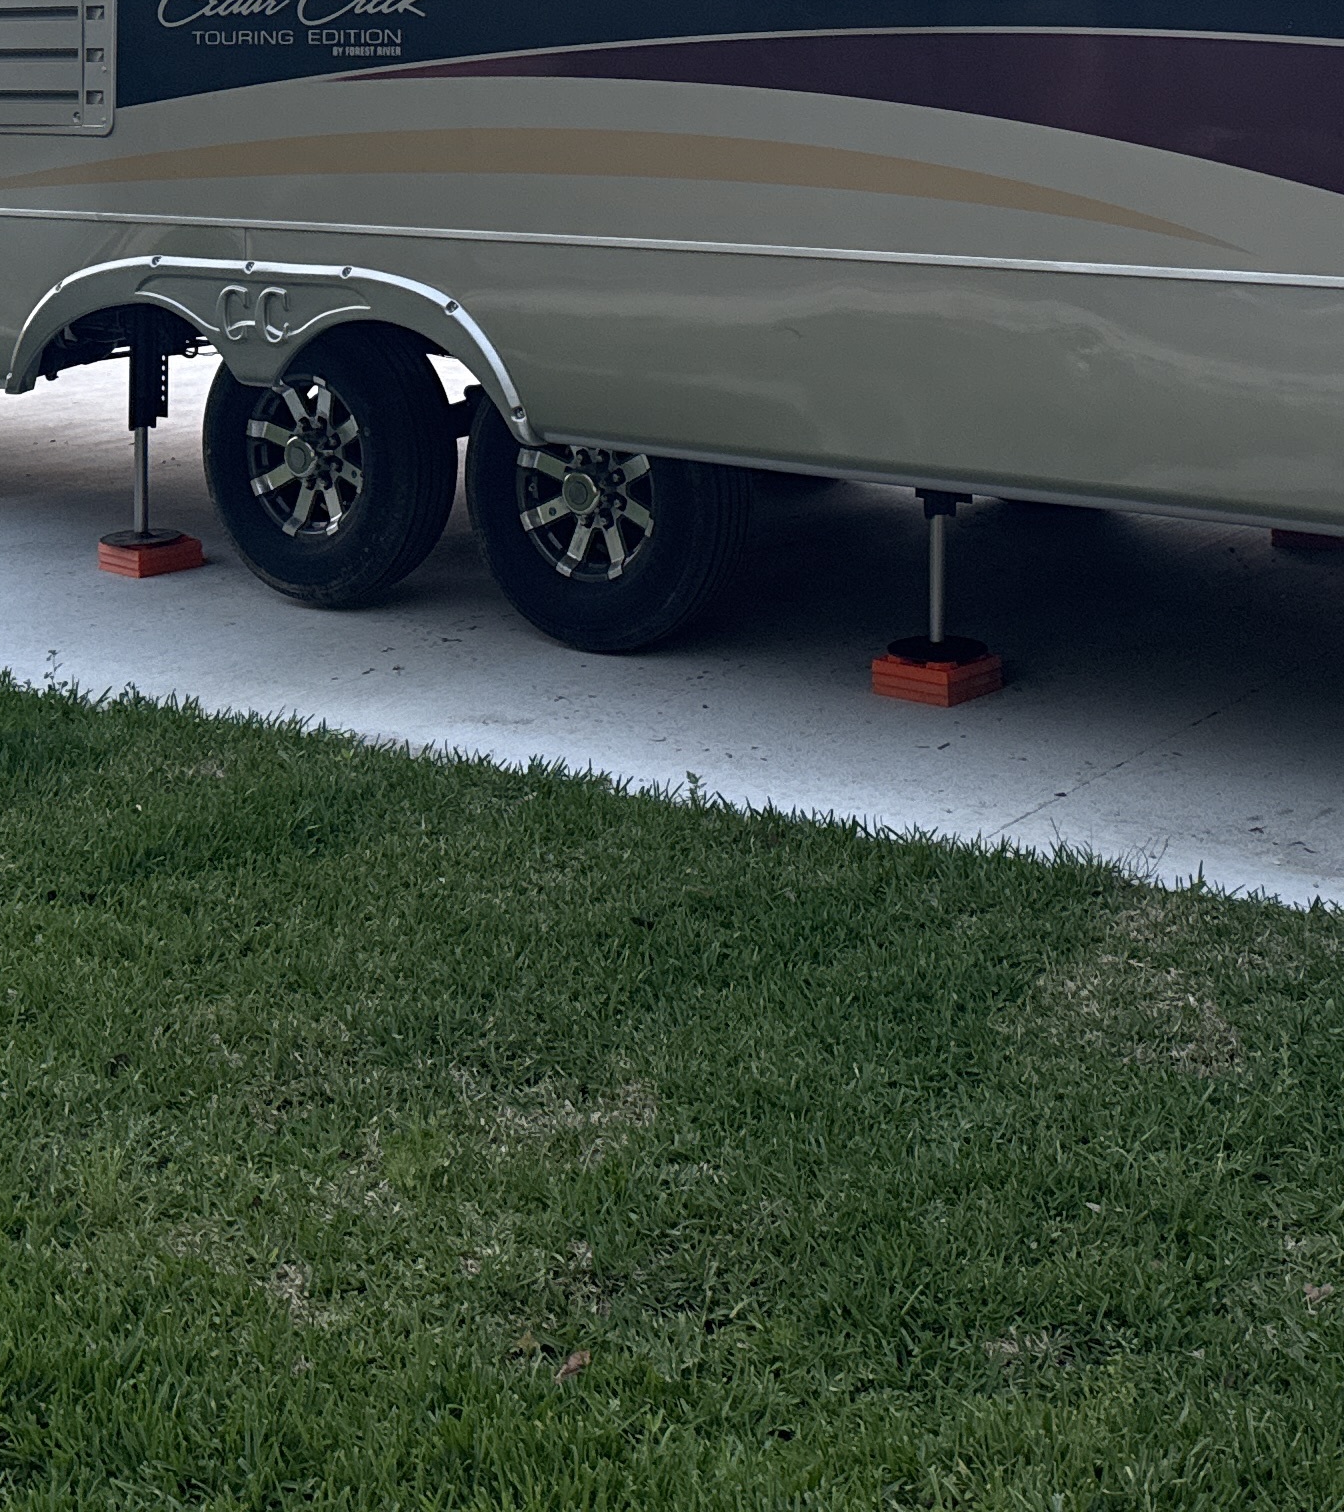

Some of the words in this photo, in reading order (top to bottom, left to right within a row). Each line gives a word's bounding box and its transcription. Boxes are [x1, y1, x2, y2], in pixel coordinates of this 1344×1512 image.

[192, 30, 294, 45] TOURING
[308, 29, 402, 44] EDITION
[332, 46, 343, 57] BY
[346, 46, 375, 57] FOREST
[376, 46, 402, 57] RIVER
